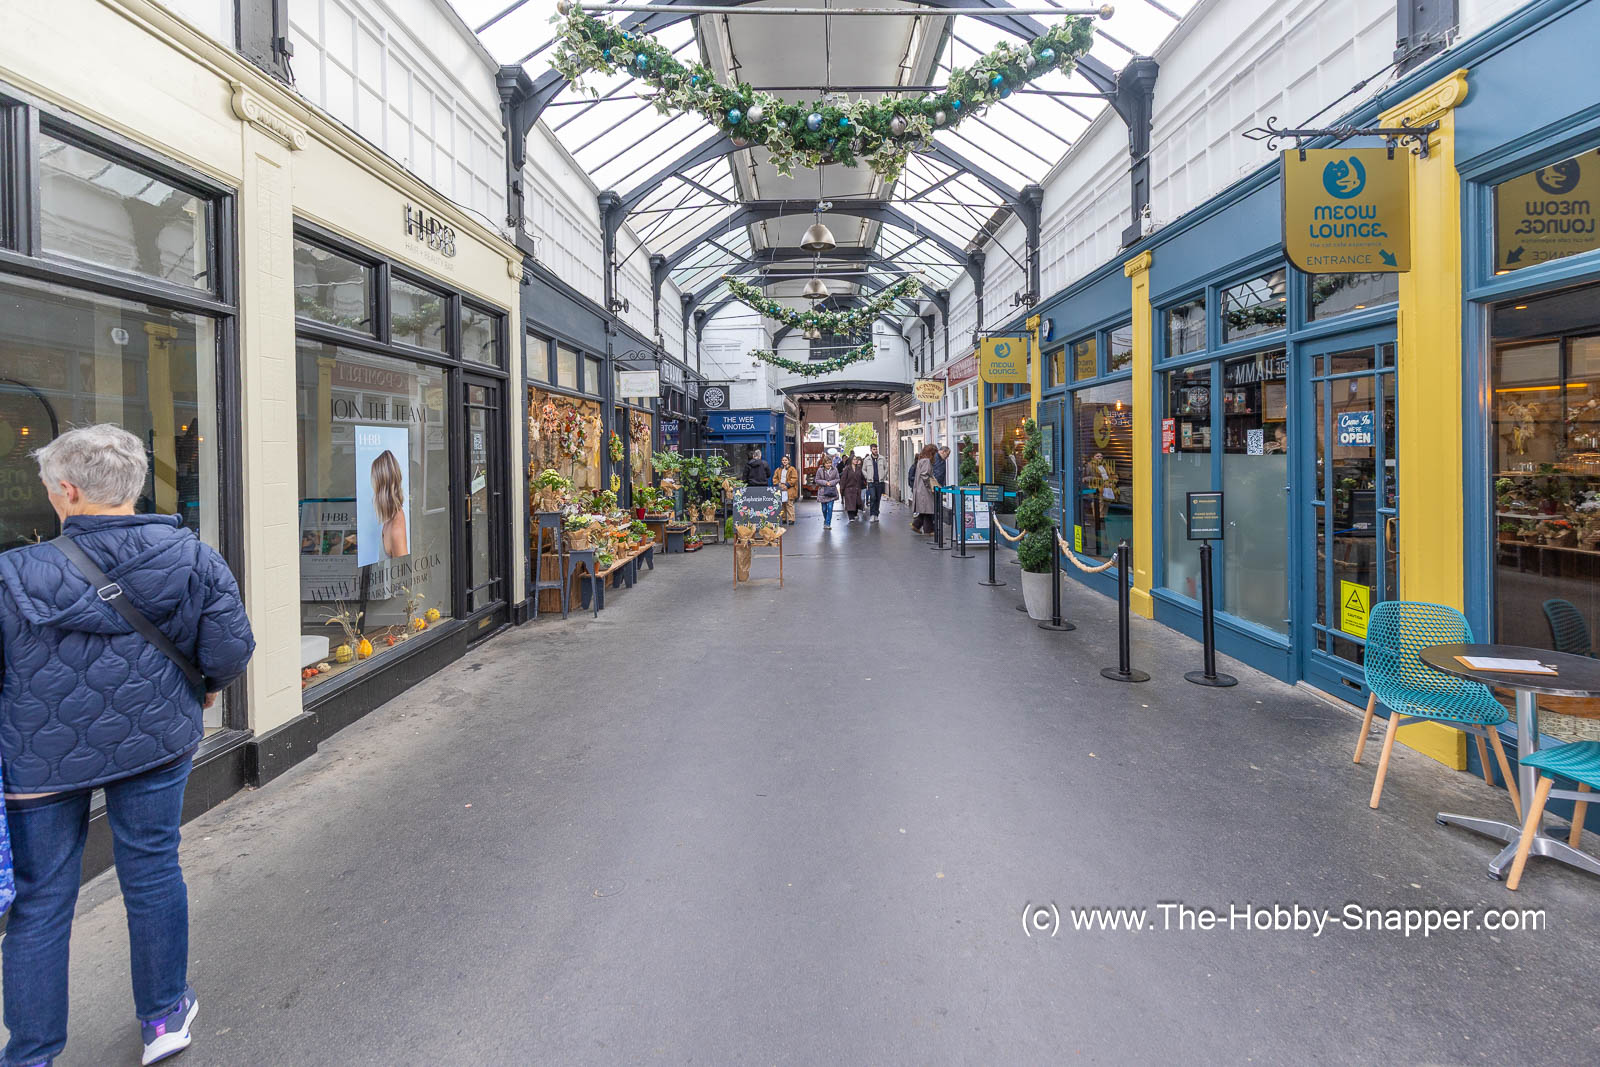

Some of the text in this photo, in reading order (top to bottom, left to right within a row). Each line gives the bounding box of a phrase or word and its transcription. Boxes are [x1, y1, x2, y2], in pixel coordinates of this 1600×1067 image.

[1314, 204, 1376, 220] MEOW
[1309, 222, 1388, 239] LOUNGE
[1306, 254, 1373, 266] ENTRANCE
[331, 398, 427, 424] JOIN THE TEAM
[1341, 415, 1360, 428] Come
[1340, 432, 1371, 444] OPEN
